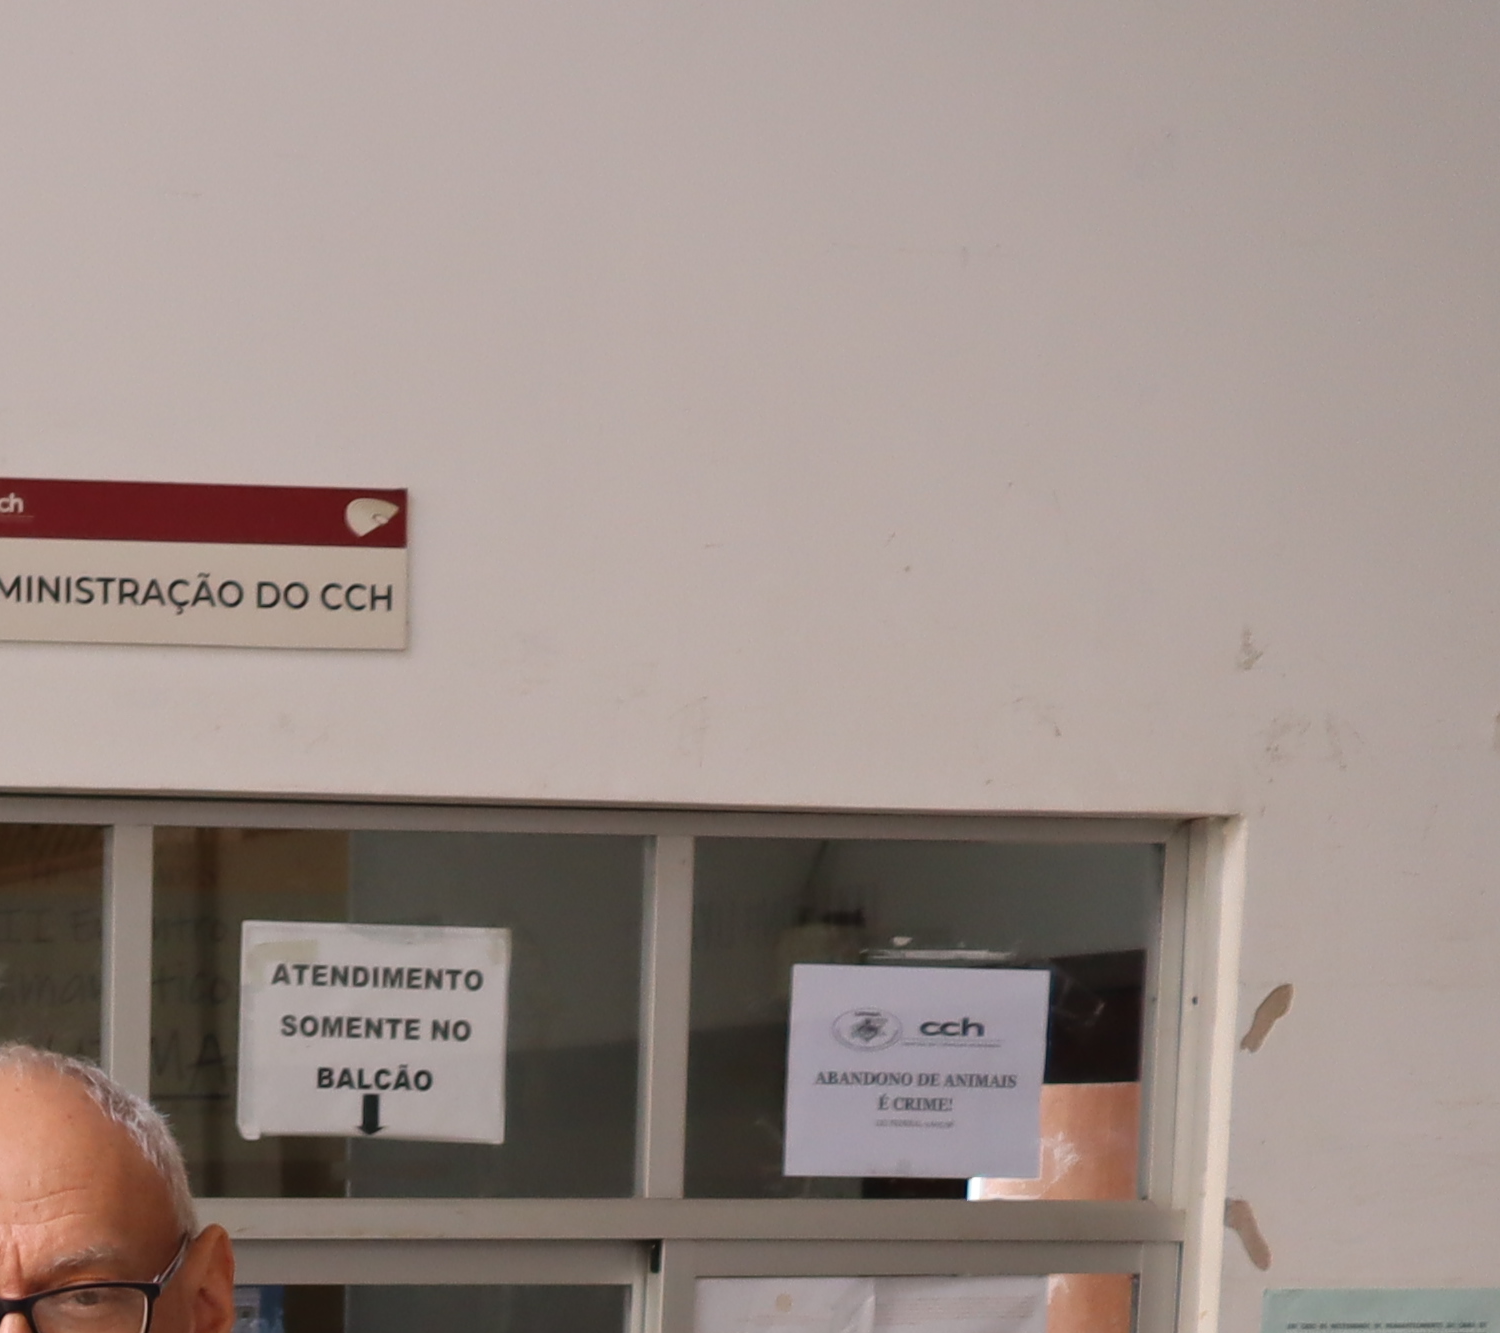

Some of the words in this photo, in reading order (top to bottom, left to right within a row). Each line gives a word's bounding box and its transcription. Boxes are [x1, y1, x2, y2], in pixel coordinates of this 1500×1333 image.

[257, 582, 308, 609] DO
[320, 584, 394, 611] CCH
[271, 962, 484, 992] ATENDIMENTO
[280, 1013, 420, 1042] SOMENTE
[431, 1017, 472, 1043] NO
[920, 1018, 985, 1037] cch
[316, 1060, 434, 1094] BALCÃO
[815, 1071, 913, 1086] ABANDONO
[917, 1073, 939, 1087] DE
[944, 1074, 1017, 1088] ANIMAIS
[878, 1094, 889, 1110] É
[893, 1097, 953, 1112] CRIME!
